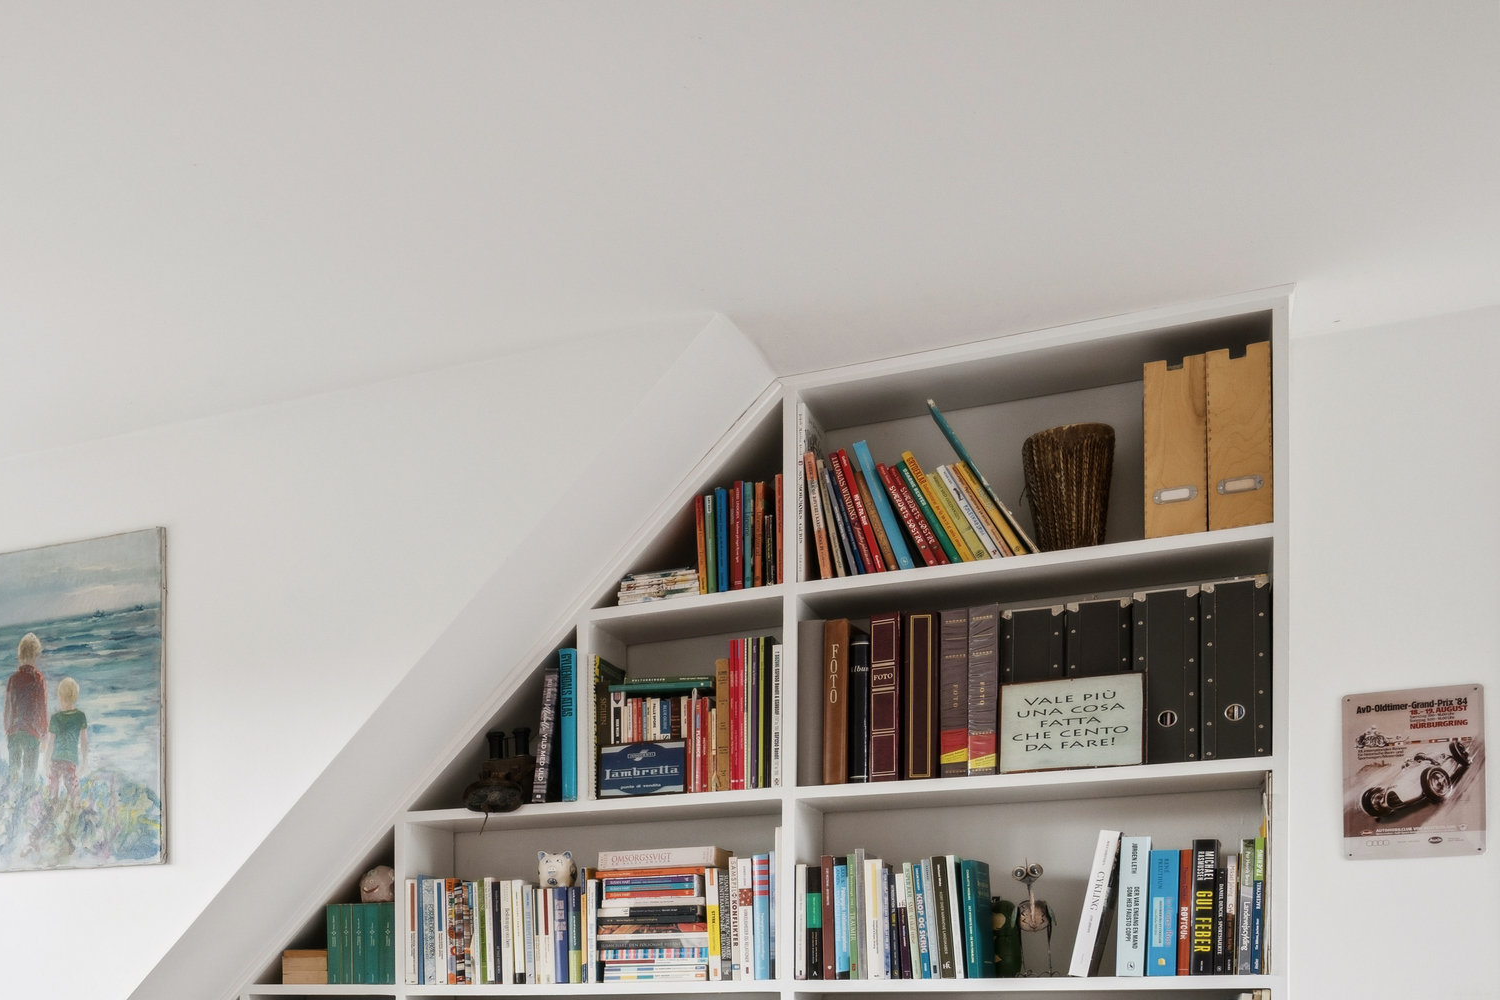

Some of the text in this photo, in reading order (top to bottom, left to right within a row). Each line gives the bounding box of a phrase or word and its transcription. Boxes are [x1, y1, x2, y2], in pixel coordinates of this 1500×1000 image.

[830, 643, 839, 704] FOTO
[873, 672, 893, 681] FOTO
[560, 653, 573, 717] GYLDENDALS ATLAS
[1024, 689, 1116, 706] VALE PIÙ
[1356, 697, 1468, 714] AvD-Oldtimer-Grand-Prix '84
[1017, 702, 1125, 718] UNA COSA
[1436, 705, 1468, 713] AUGUST
[1040, 716, 1101, 728] FATTA
[1409, 719, 1468, 729] NÜRBURGRING
[1012, 725, 1129, 742] CHE CENTO
[1025, 737, 1115, 752] DA FARE!
[539, 750, 547, 766] MED
[537, 767, 545, 782] ULD
[611, 852, 672, 863] OMSORGSSVIGT
[1196, 850, 1205, 881] RASMUSSEN
[1203, 850, 1215, 881] MICHAEL
[1089, 871, 1106, 911] CYKLING
[916, 893, 928, 954] KROP OG SKRIG
[1194, 890, 1213, 952] GUL FEBER
[1240, 901, 1251, 951] Landevejscykling
